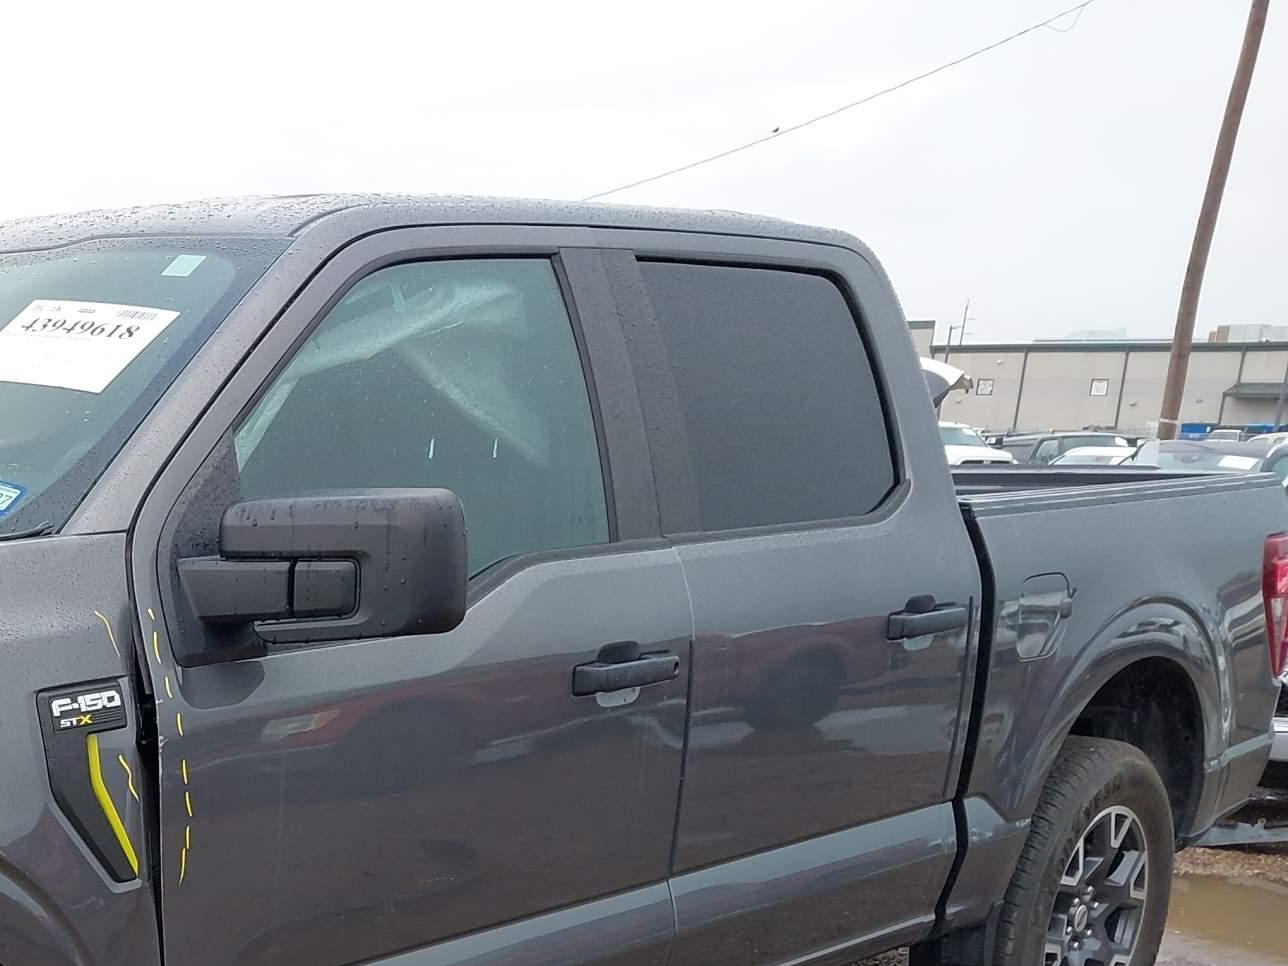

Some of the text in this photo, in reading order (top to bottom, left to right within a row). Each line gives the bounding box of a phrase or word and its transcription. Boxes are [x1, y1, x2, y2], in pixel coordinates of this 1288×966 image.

[21, 316, 141, 340] 43949618
[51, 690, 122, 717] F-150
[59, 714, 93, 728] STX
